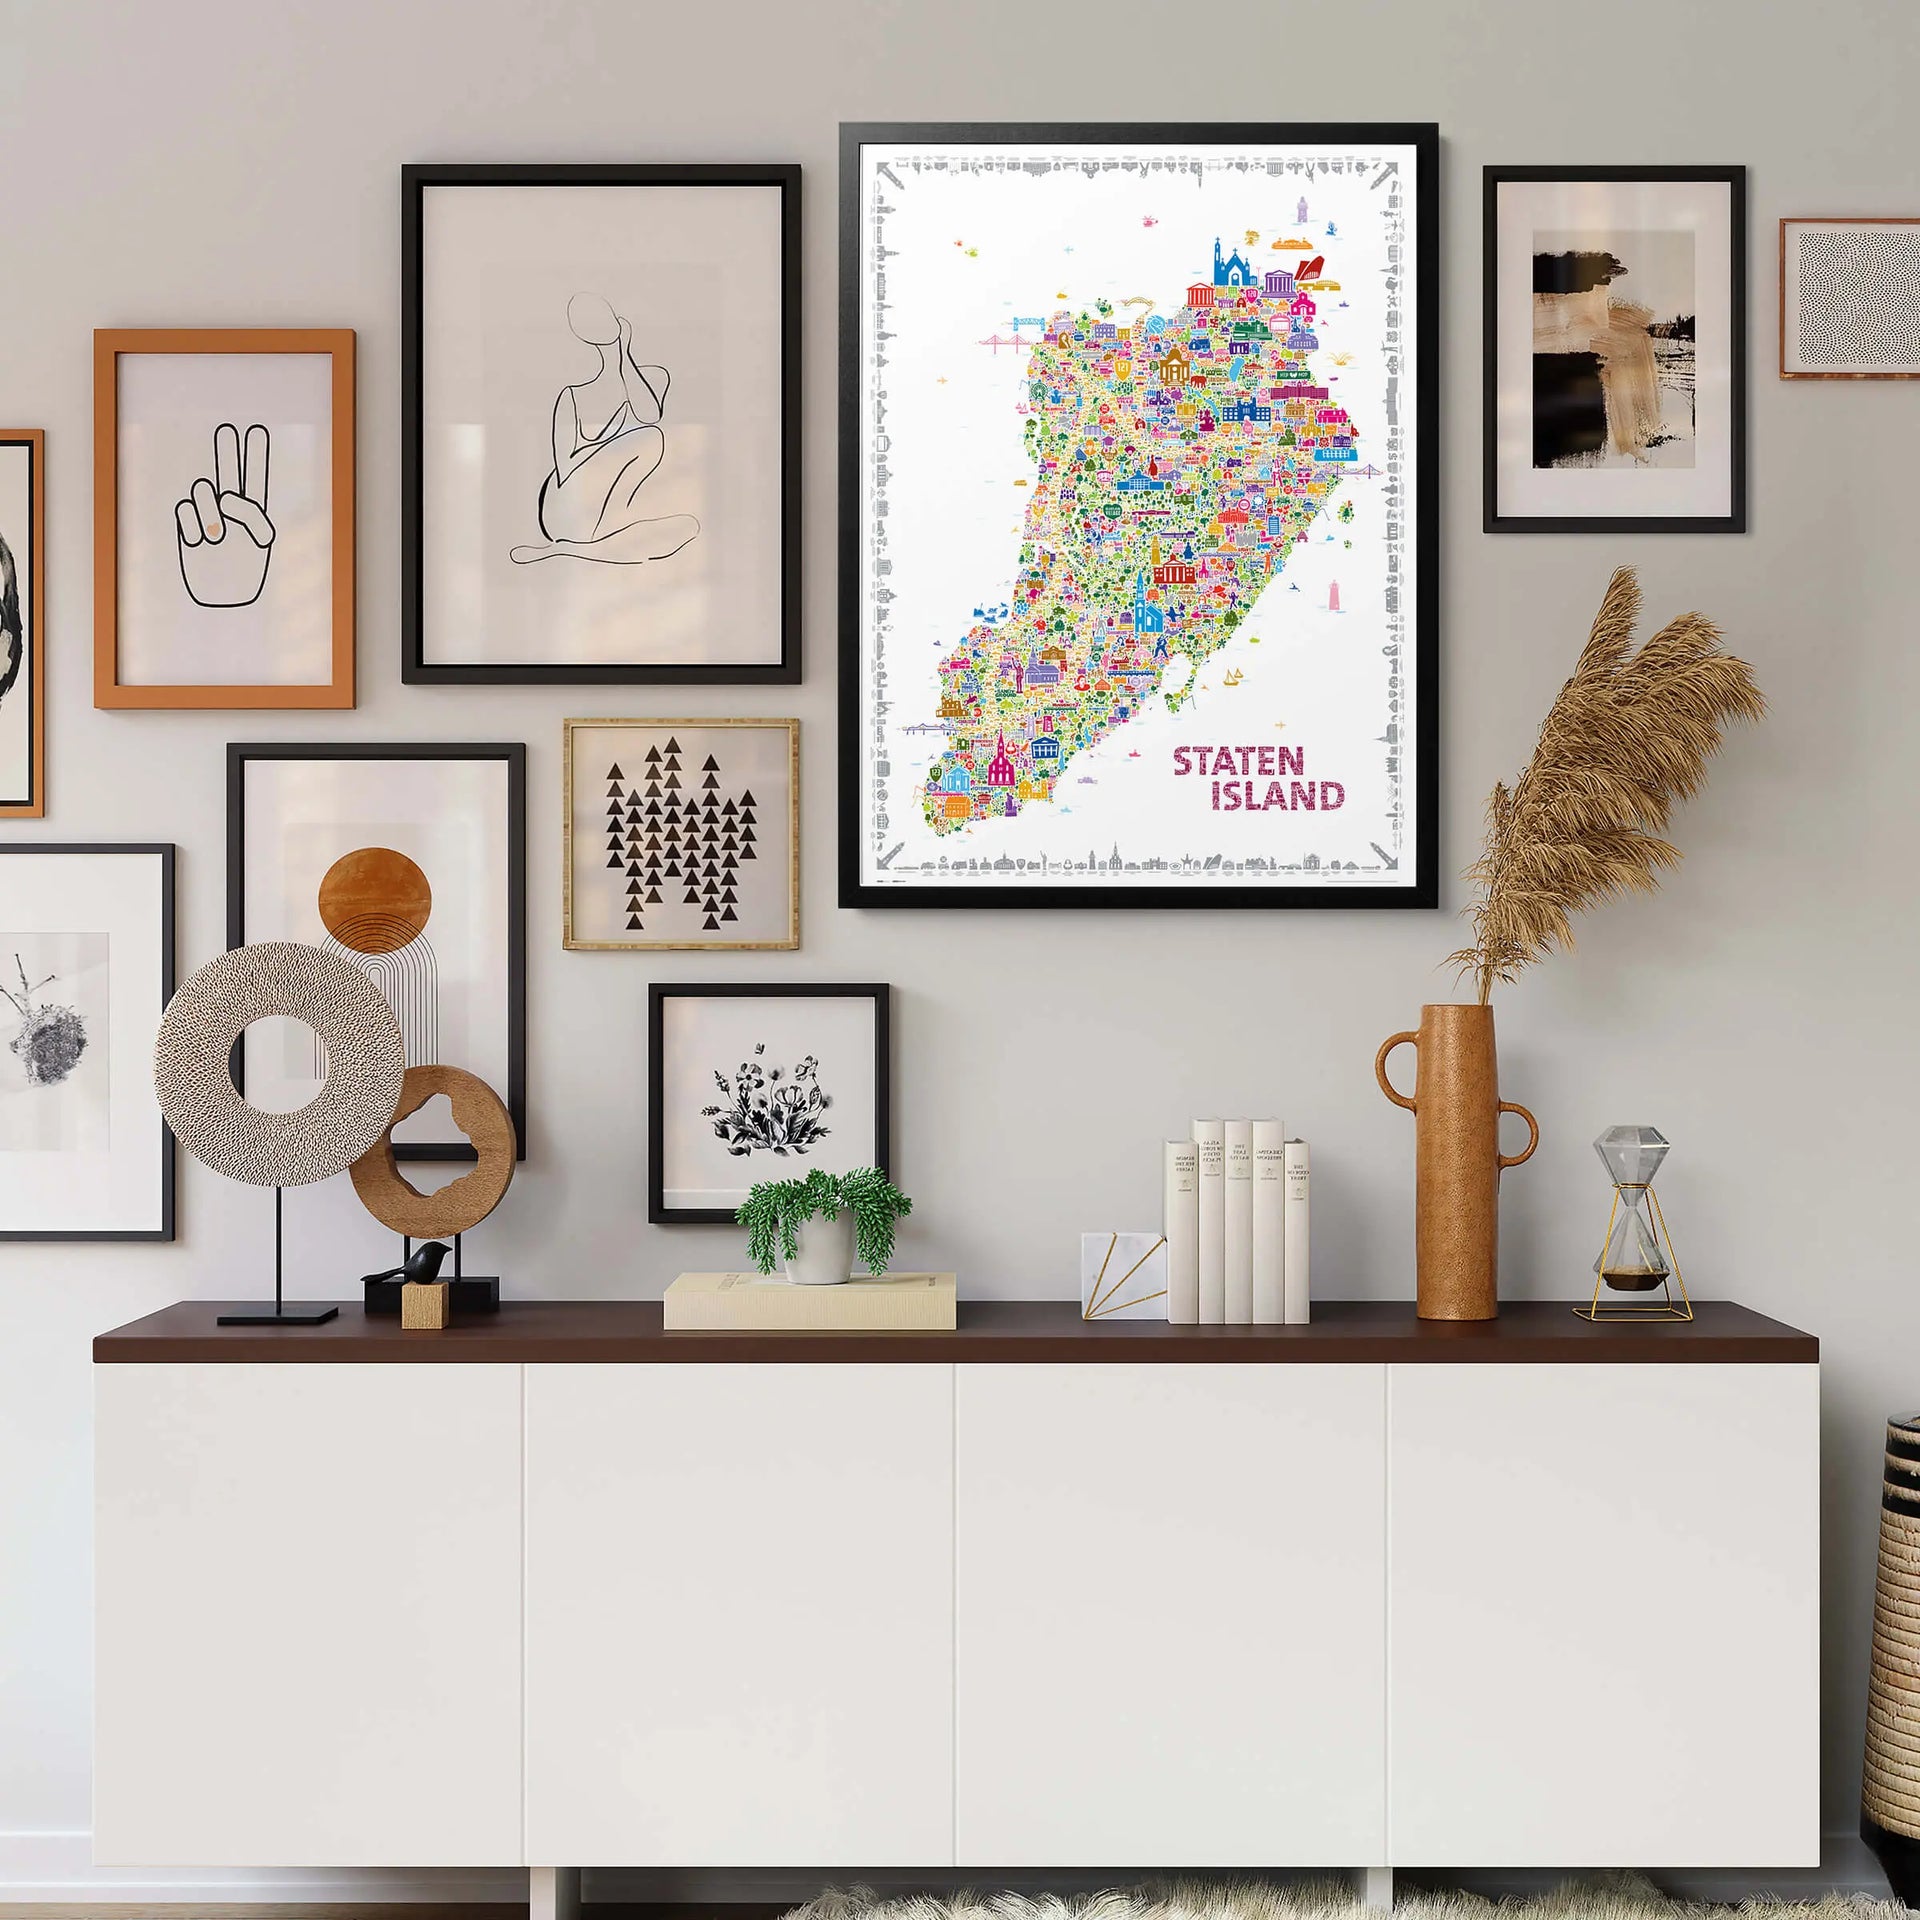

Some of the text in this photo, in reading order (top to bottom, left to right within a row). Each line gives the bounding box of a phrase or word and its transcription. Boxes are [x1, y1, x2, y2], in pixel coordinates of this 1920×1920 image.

[1117, 362, 1128, 372] 121
[1173, 746, 1304, 776] STATEN
[1211, 780, 1346, 811] ISLAND
